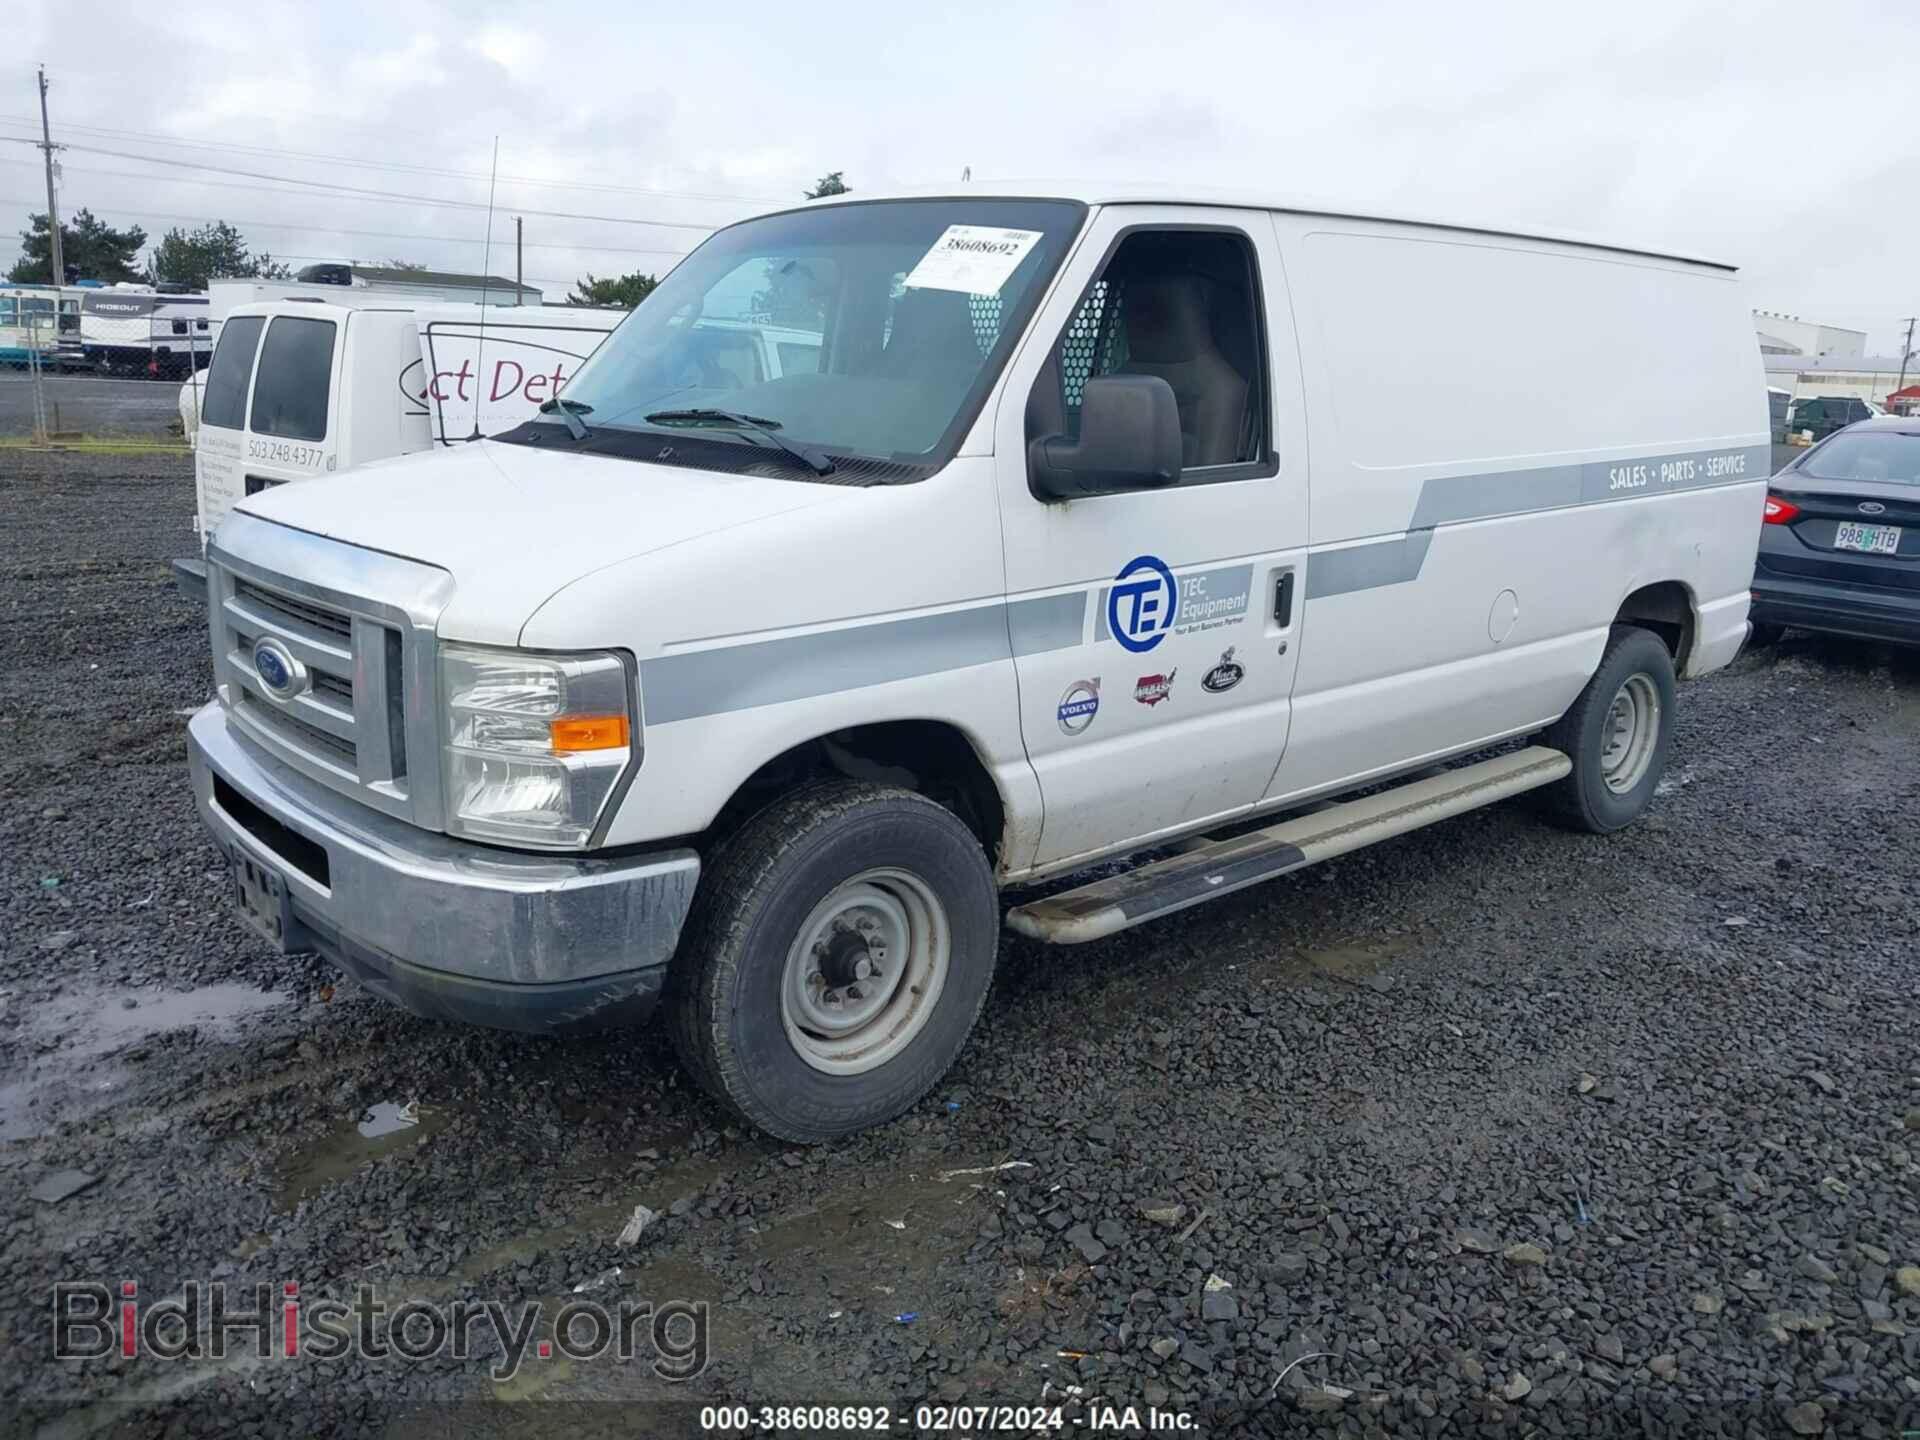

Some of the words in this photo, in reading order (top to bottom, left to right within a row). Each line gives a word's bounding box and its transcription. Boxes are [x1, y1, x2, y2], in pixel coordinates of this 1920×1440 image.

[942, 238, 1018, 255] 38608692
[95, 303, 140, 312] HIDEOUT
[419, 359, 474, 402] ct
[248, 440, 323, 467] 503.248.4377
[1610, 465, 1647, 490] SALES
[1661, 460, 1695, 482] PARTS
[1706, 454, 1745, 477] SERVICE
[1840, 527, 1864, 544] 988
[1871, 531, 1897, 548] HTB
[1183, 576, 1207, 597] TEC
[1182, 592, 1247, 620] Equipment
[1061, 701, 1097, 717] VOLVO
